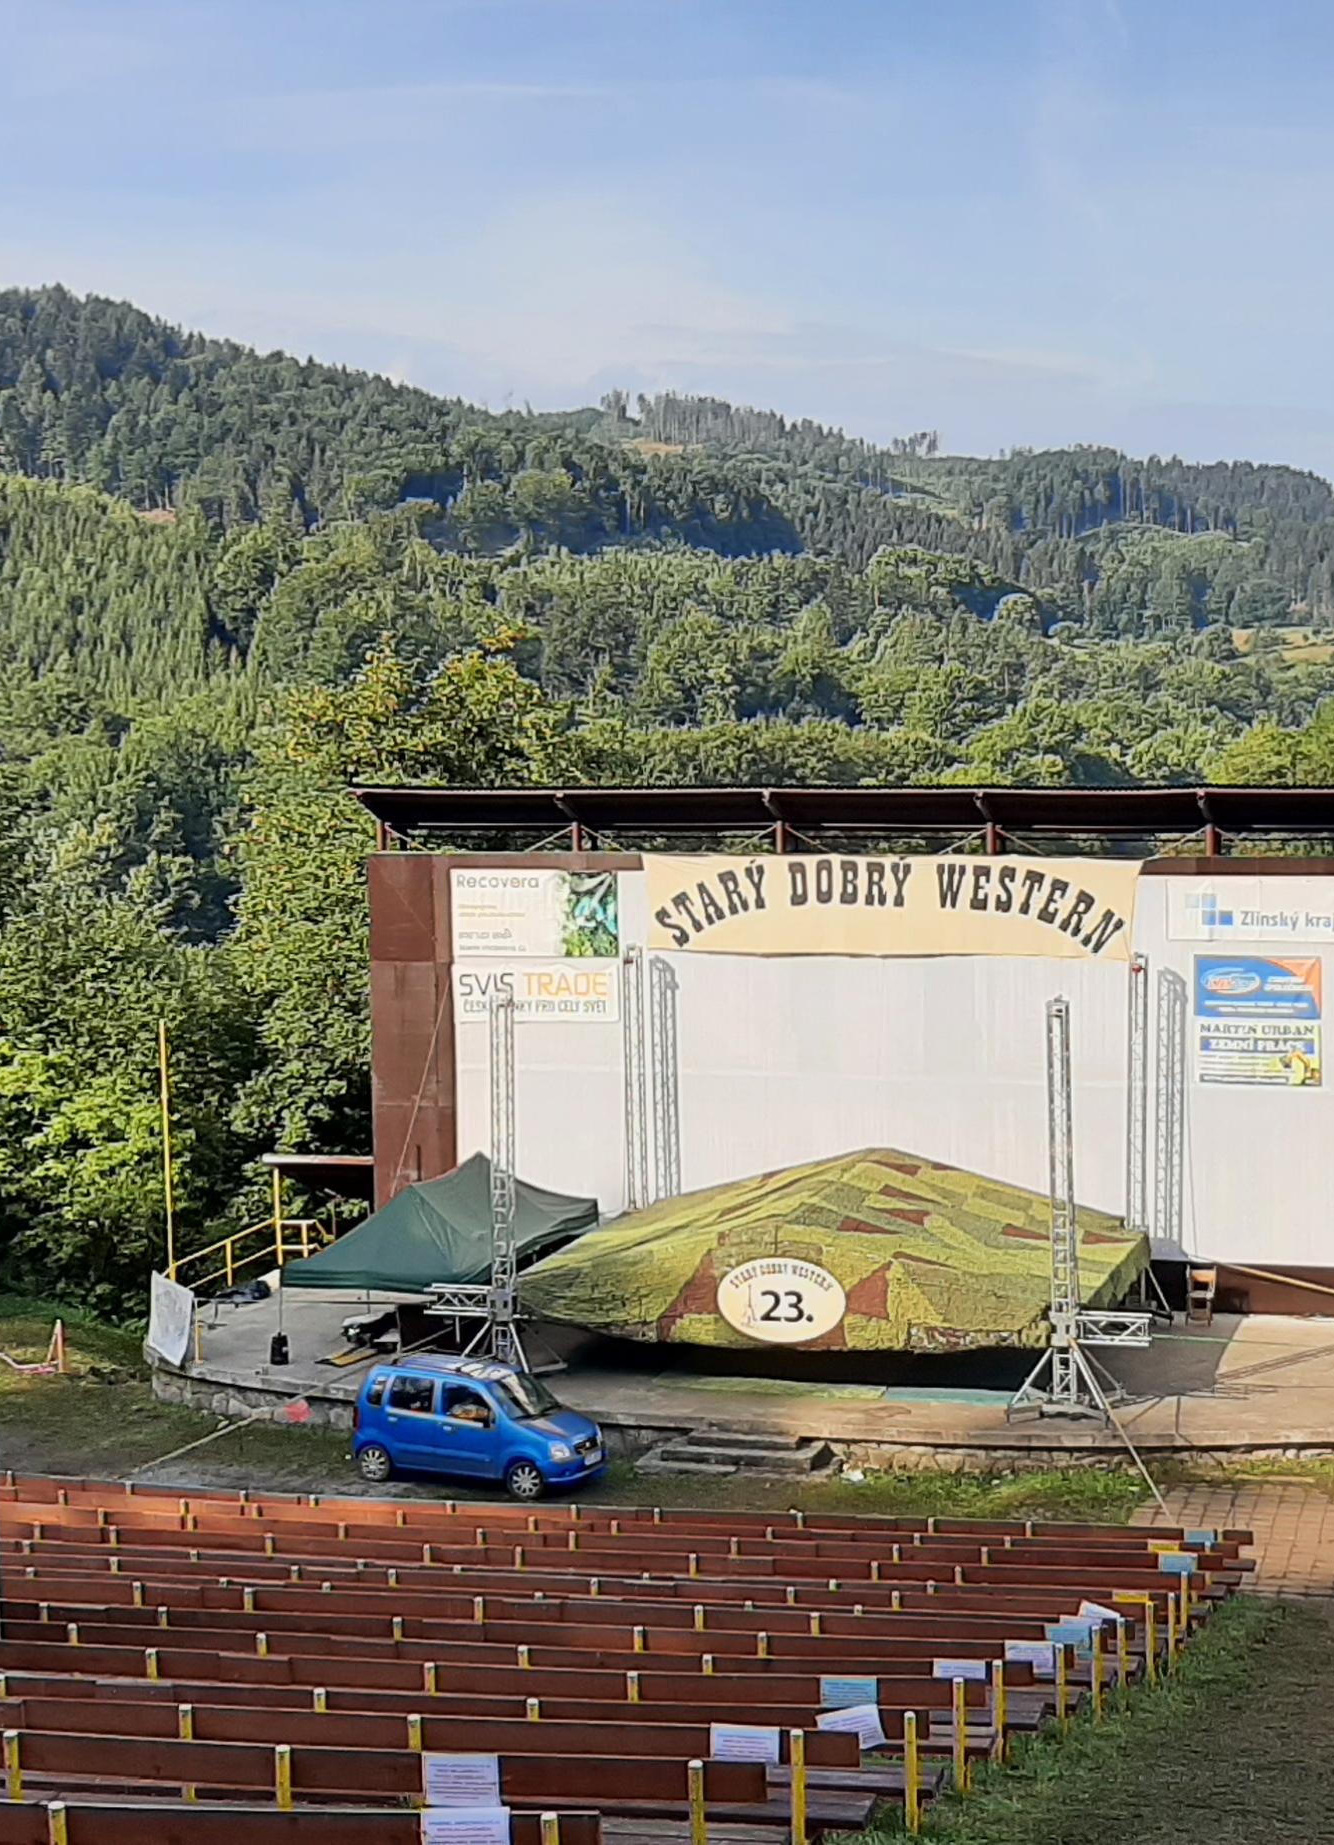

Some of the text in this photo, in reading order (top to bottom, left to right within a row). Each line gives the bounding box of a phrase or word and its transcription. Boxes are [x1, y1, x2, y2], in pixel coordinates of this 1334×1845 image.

[456, 874, 539, 889] Recovera
[655, 856, 1125, 956] STARÝ DOBRÝ WESTERN
[523, 972, 607, 996] TRADE
[1200, 1023, 1315, 1035] MARTIN URBAN
[760, 1290, 814, 1322] 23.
